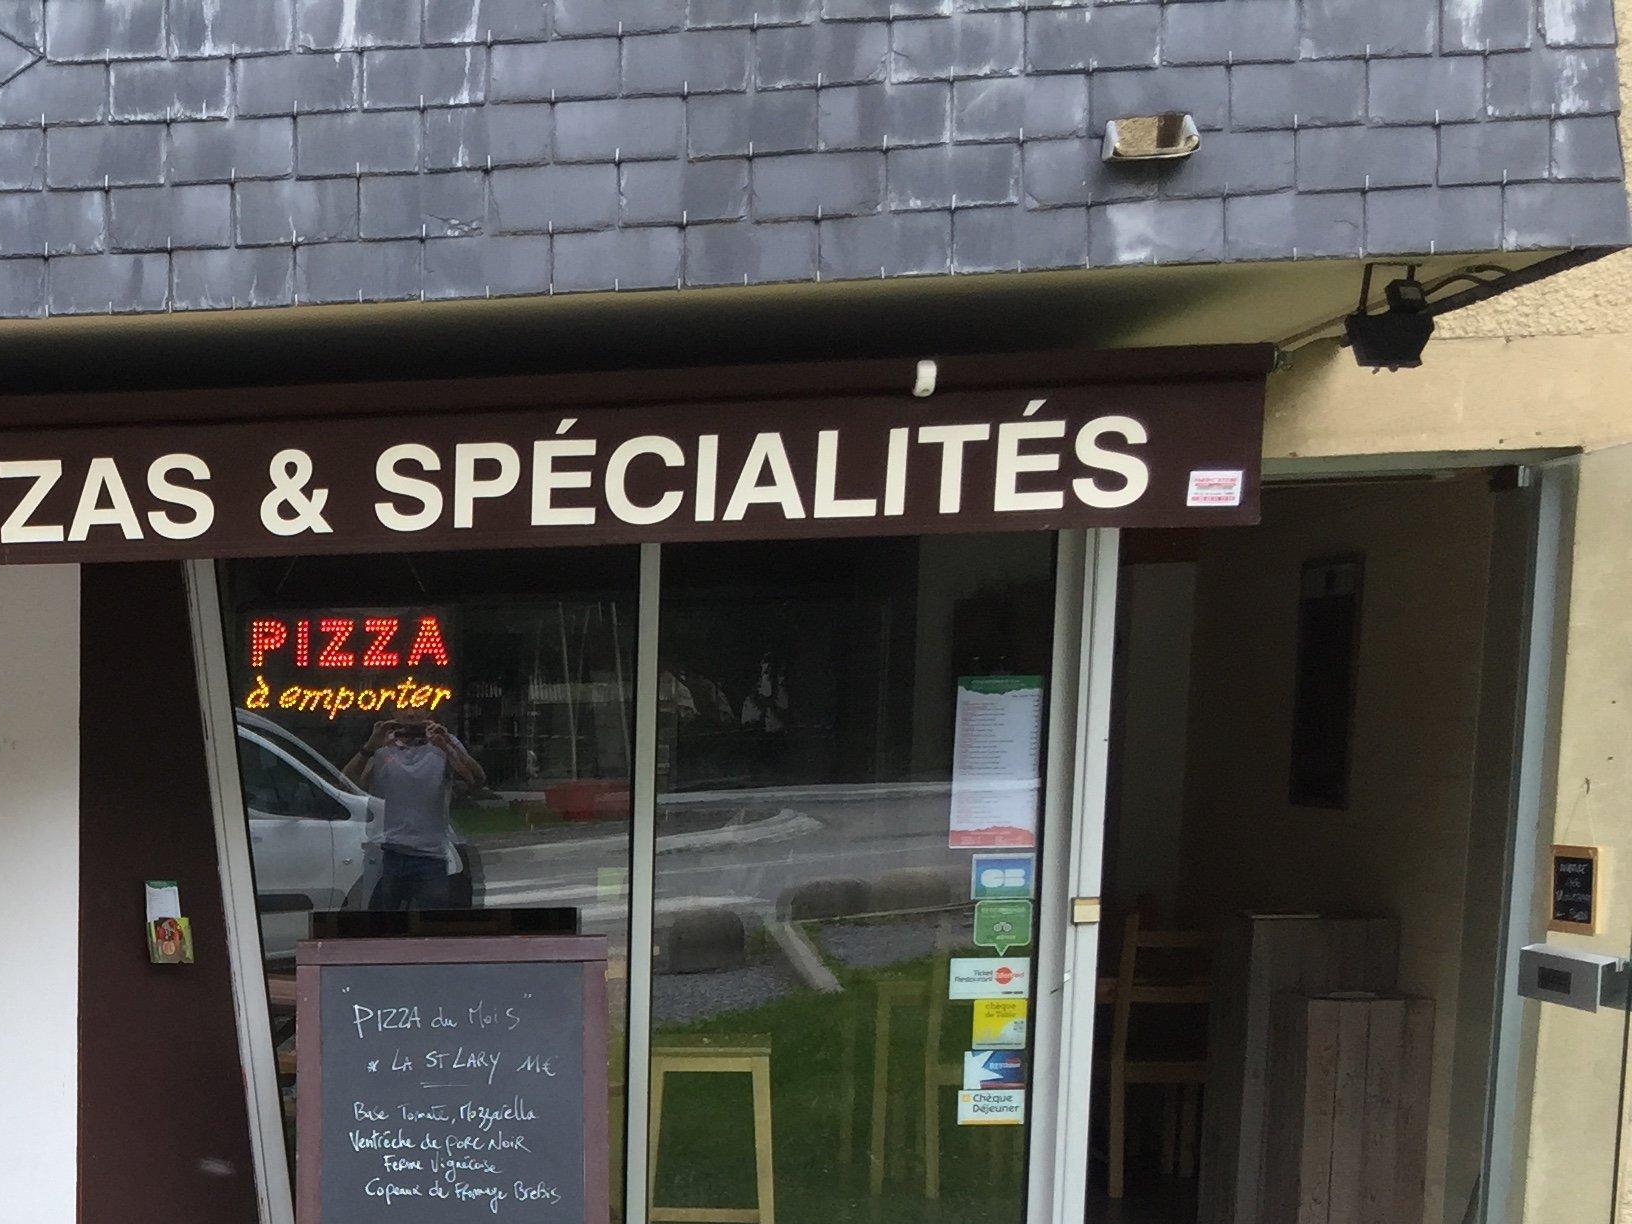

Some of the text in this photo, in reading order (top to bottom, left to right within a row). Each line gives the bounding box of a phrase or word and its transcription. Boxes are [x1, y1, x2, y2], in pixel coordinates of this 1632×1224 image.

[259, 449, 334, 536] &
[373, 399, 1149, 532] SPÉCIALITÉS
[250, 617, 450, 669] PIZZA
[245, 675, 452, 721] à emporter
[980, 868, 1026, 888] CB
[352, 1004, 421, 1039] PIZZA
[430, 1006, 458, 1028] du
[972, 1093, 1013, 1104] Chèque
[353, 1101, 390, 1121] Base
[972, 1104, 1019, 1115] Déjeuner
[420, 1133, 442, 1150] de
[428, 1181, 450, 1200] de
